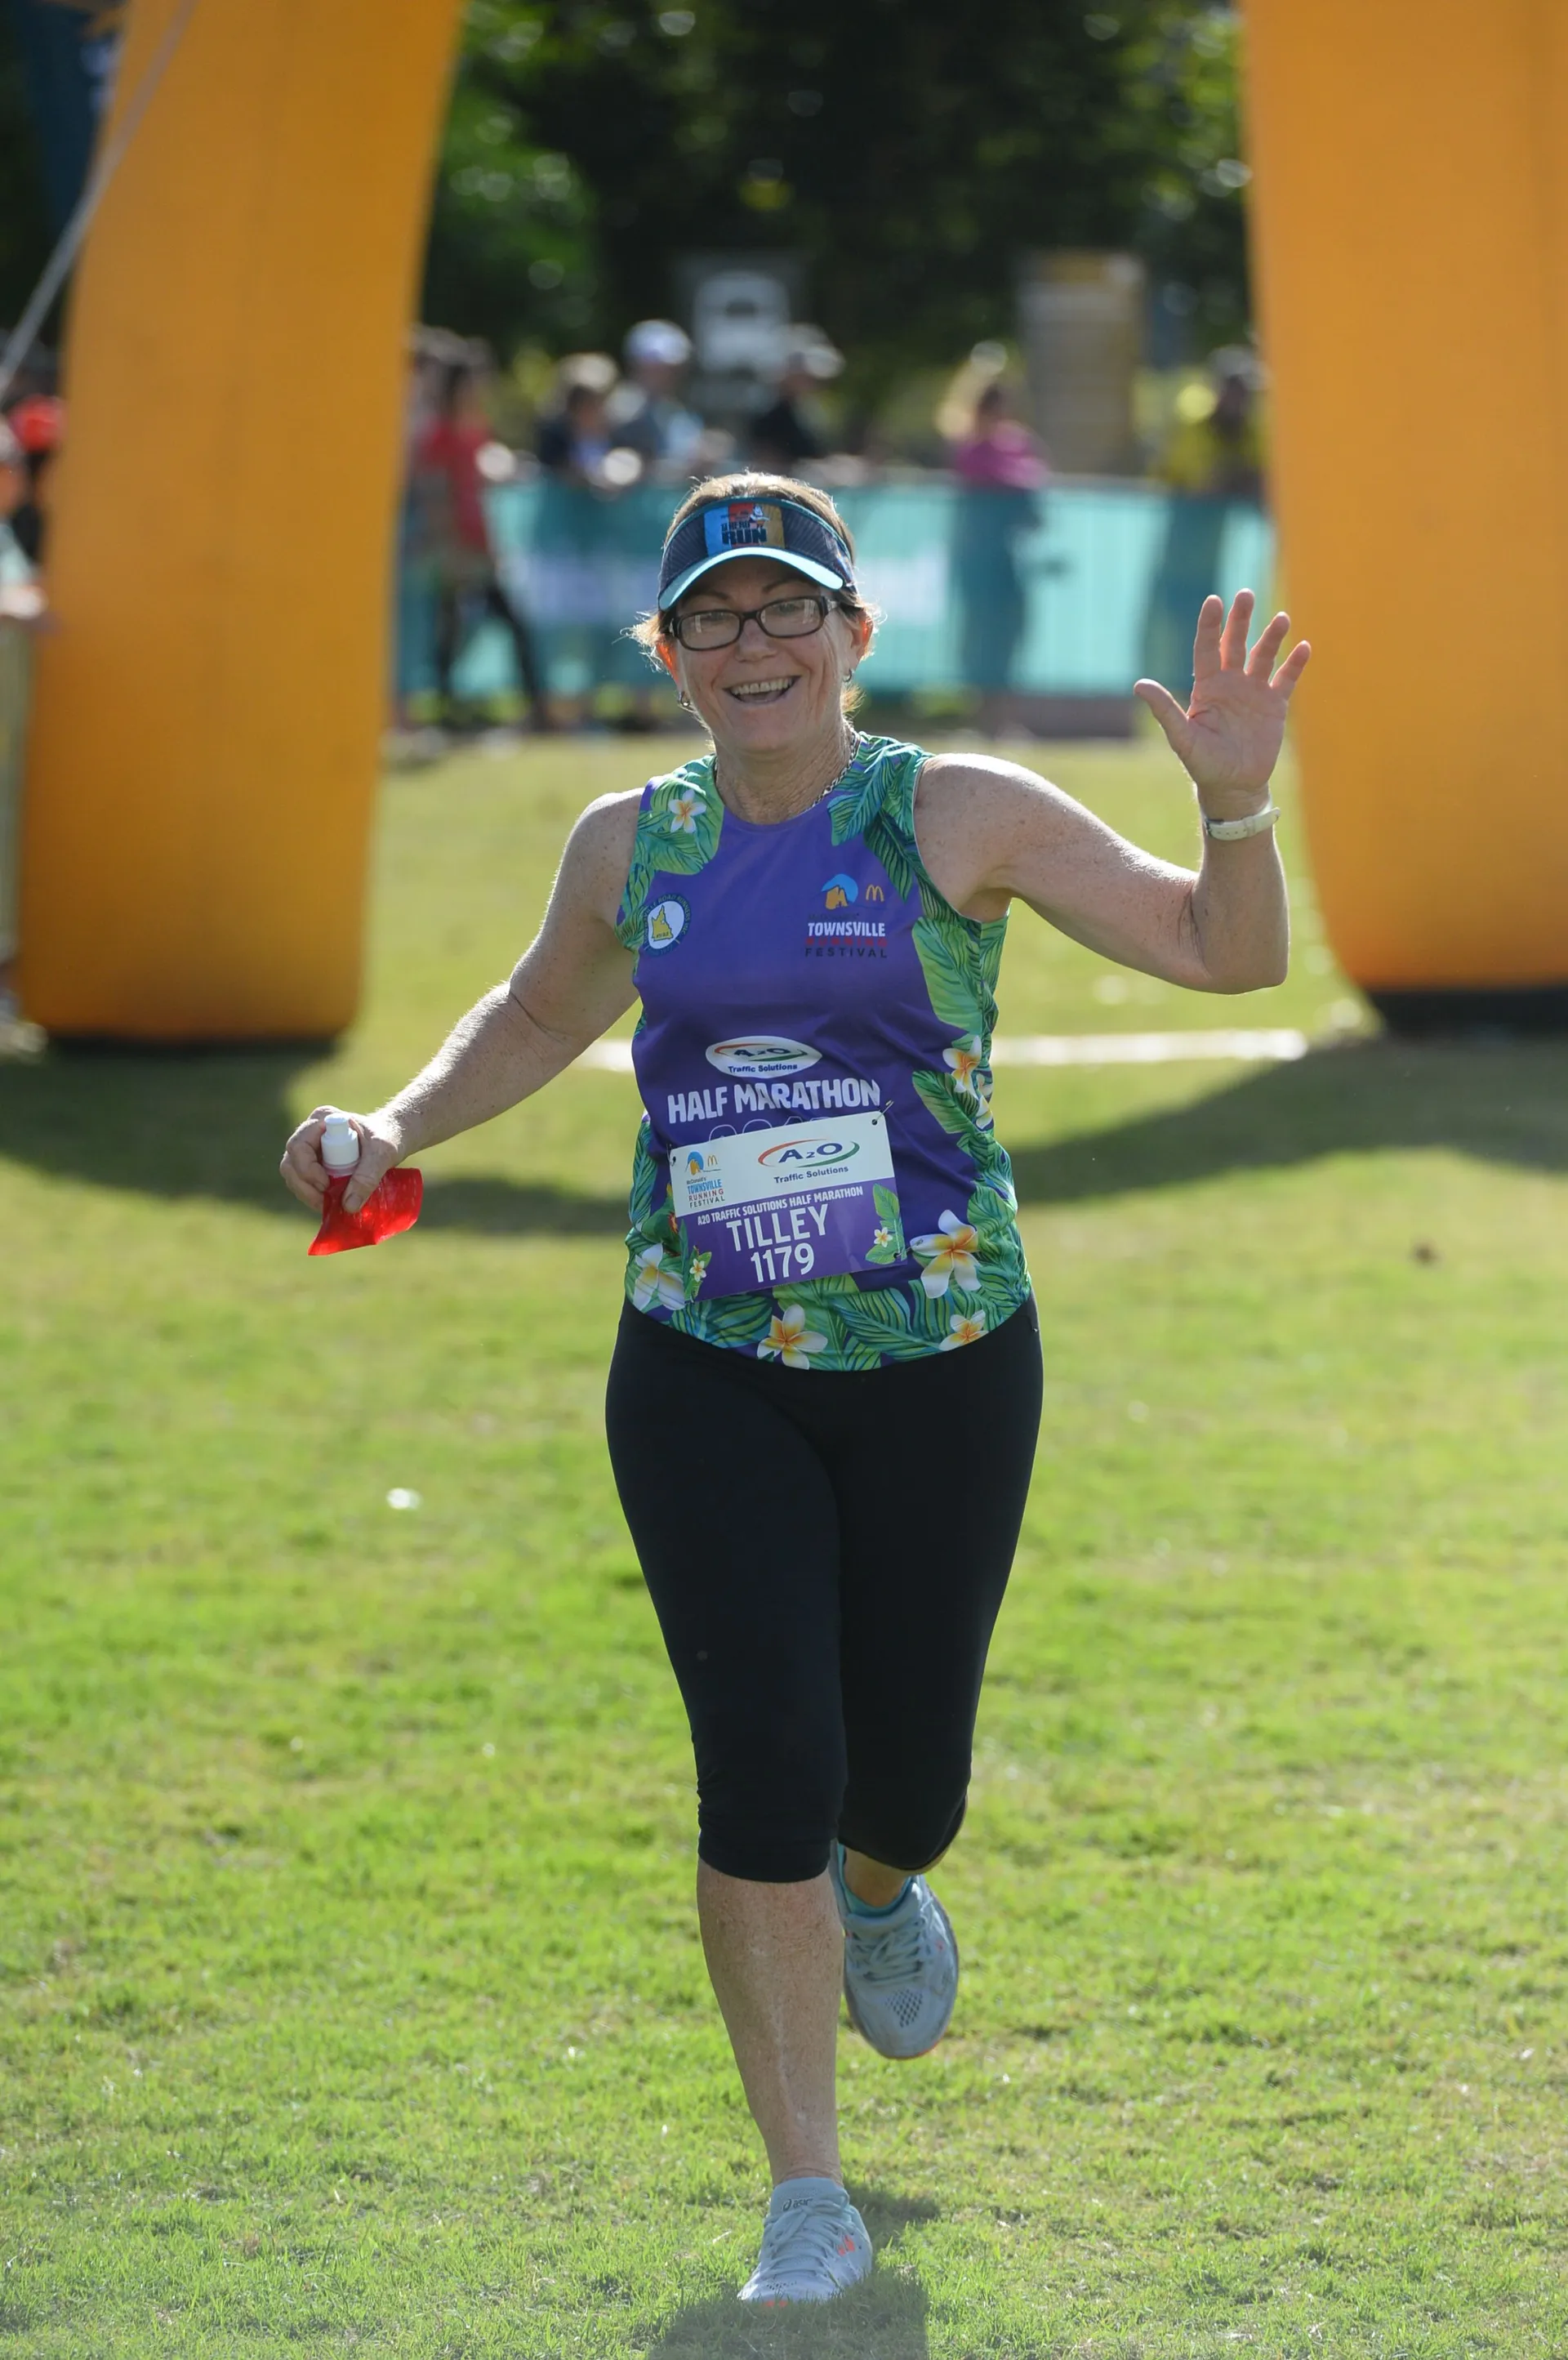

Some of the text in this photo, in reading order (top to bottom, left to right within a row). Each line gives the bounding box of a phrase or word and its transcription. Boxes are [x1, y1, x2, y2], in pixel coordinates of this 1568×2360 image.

[722, 529, 767, 545] RUN
[808, 921, 885, 937] TOWNSVILLE
[805, 948, 887, 958] FESTIVAL
[728, 1063, 798, 1073] Traffic Solutions
[667, 1077, 880, 1124] HALF MARATHON
[774, 1165, 849, 1184] Traffic Solutions
[688, 1179, 722, 1194] TOWNSVILLE
[688, 1189, 724, 1202] RUNNING
[689, 1196, 725, 1208] FESTIVAL
[710, 1207, 741, 1223] TRAFFIC
[742, 1198, 787, 1216] SOLUTIONS
[789, 1193, 812, 1207] HALF
[813, 1185, 863, 1202] MARATHON
[726, 1204, 828, 1251] TILLEY
[751, 1242, 814, 1283] 1179
